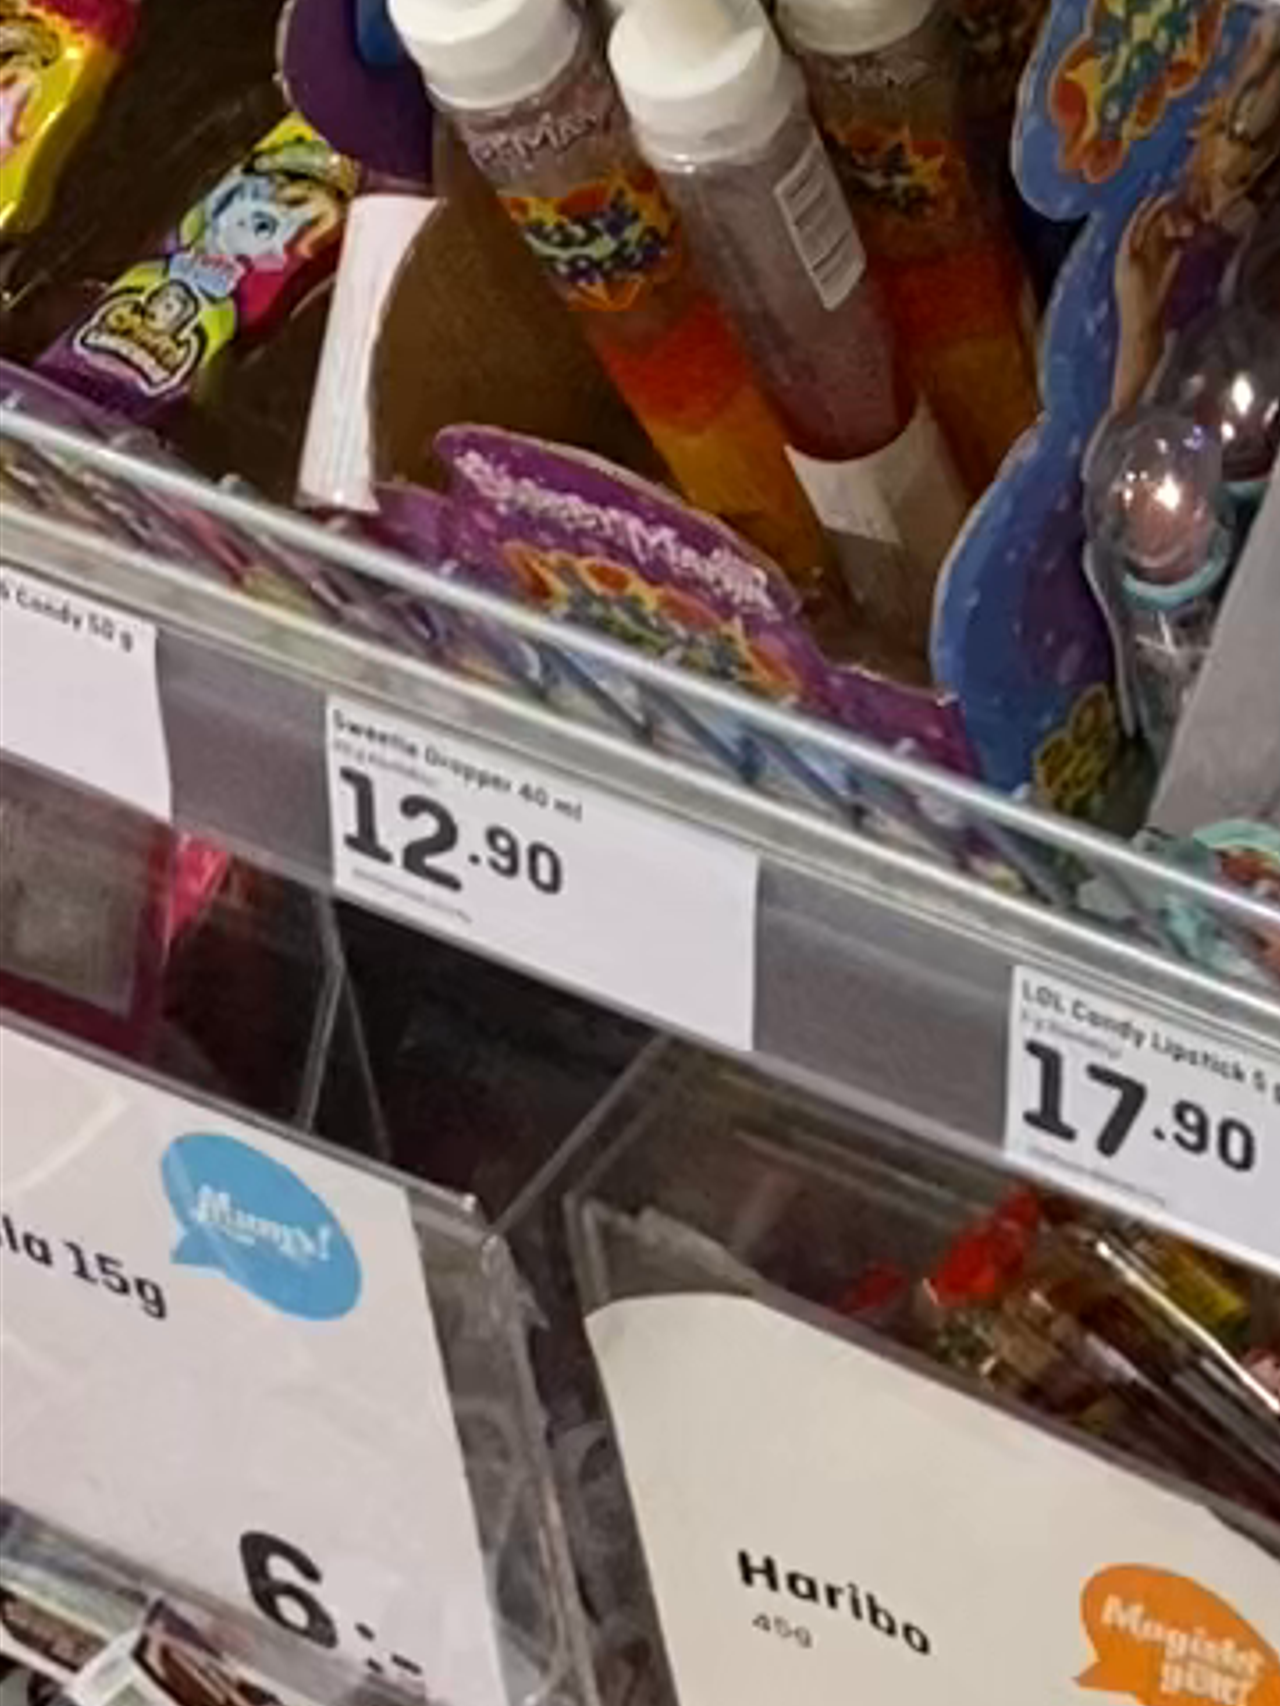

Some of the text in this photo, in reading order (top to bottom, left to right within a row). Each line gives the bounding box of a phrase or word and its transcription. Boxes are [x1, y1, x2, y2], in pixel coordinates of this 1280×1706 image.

[339, 766, 563, 896] 12.90
[425, 744, 511, 794] Dropper
[518, 779, 549, 809] 40
[554, 794, 584, 823] ml
[1021, 978, 1065, 1018] LOL
[1071, 998, 1147, 1050] Candy
[1152, 1030, 1247, 1084] Lipstick
[1252, 1070, 1266, 1094] 5
[1023, 1039, 1256, 1173] 17.90
[65, 1240, 168, 1319] 15g
[736, 1549, 932, 1655] Haribo
[751, 1611, 813, 1650] 45g
